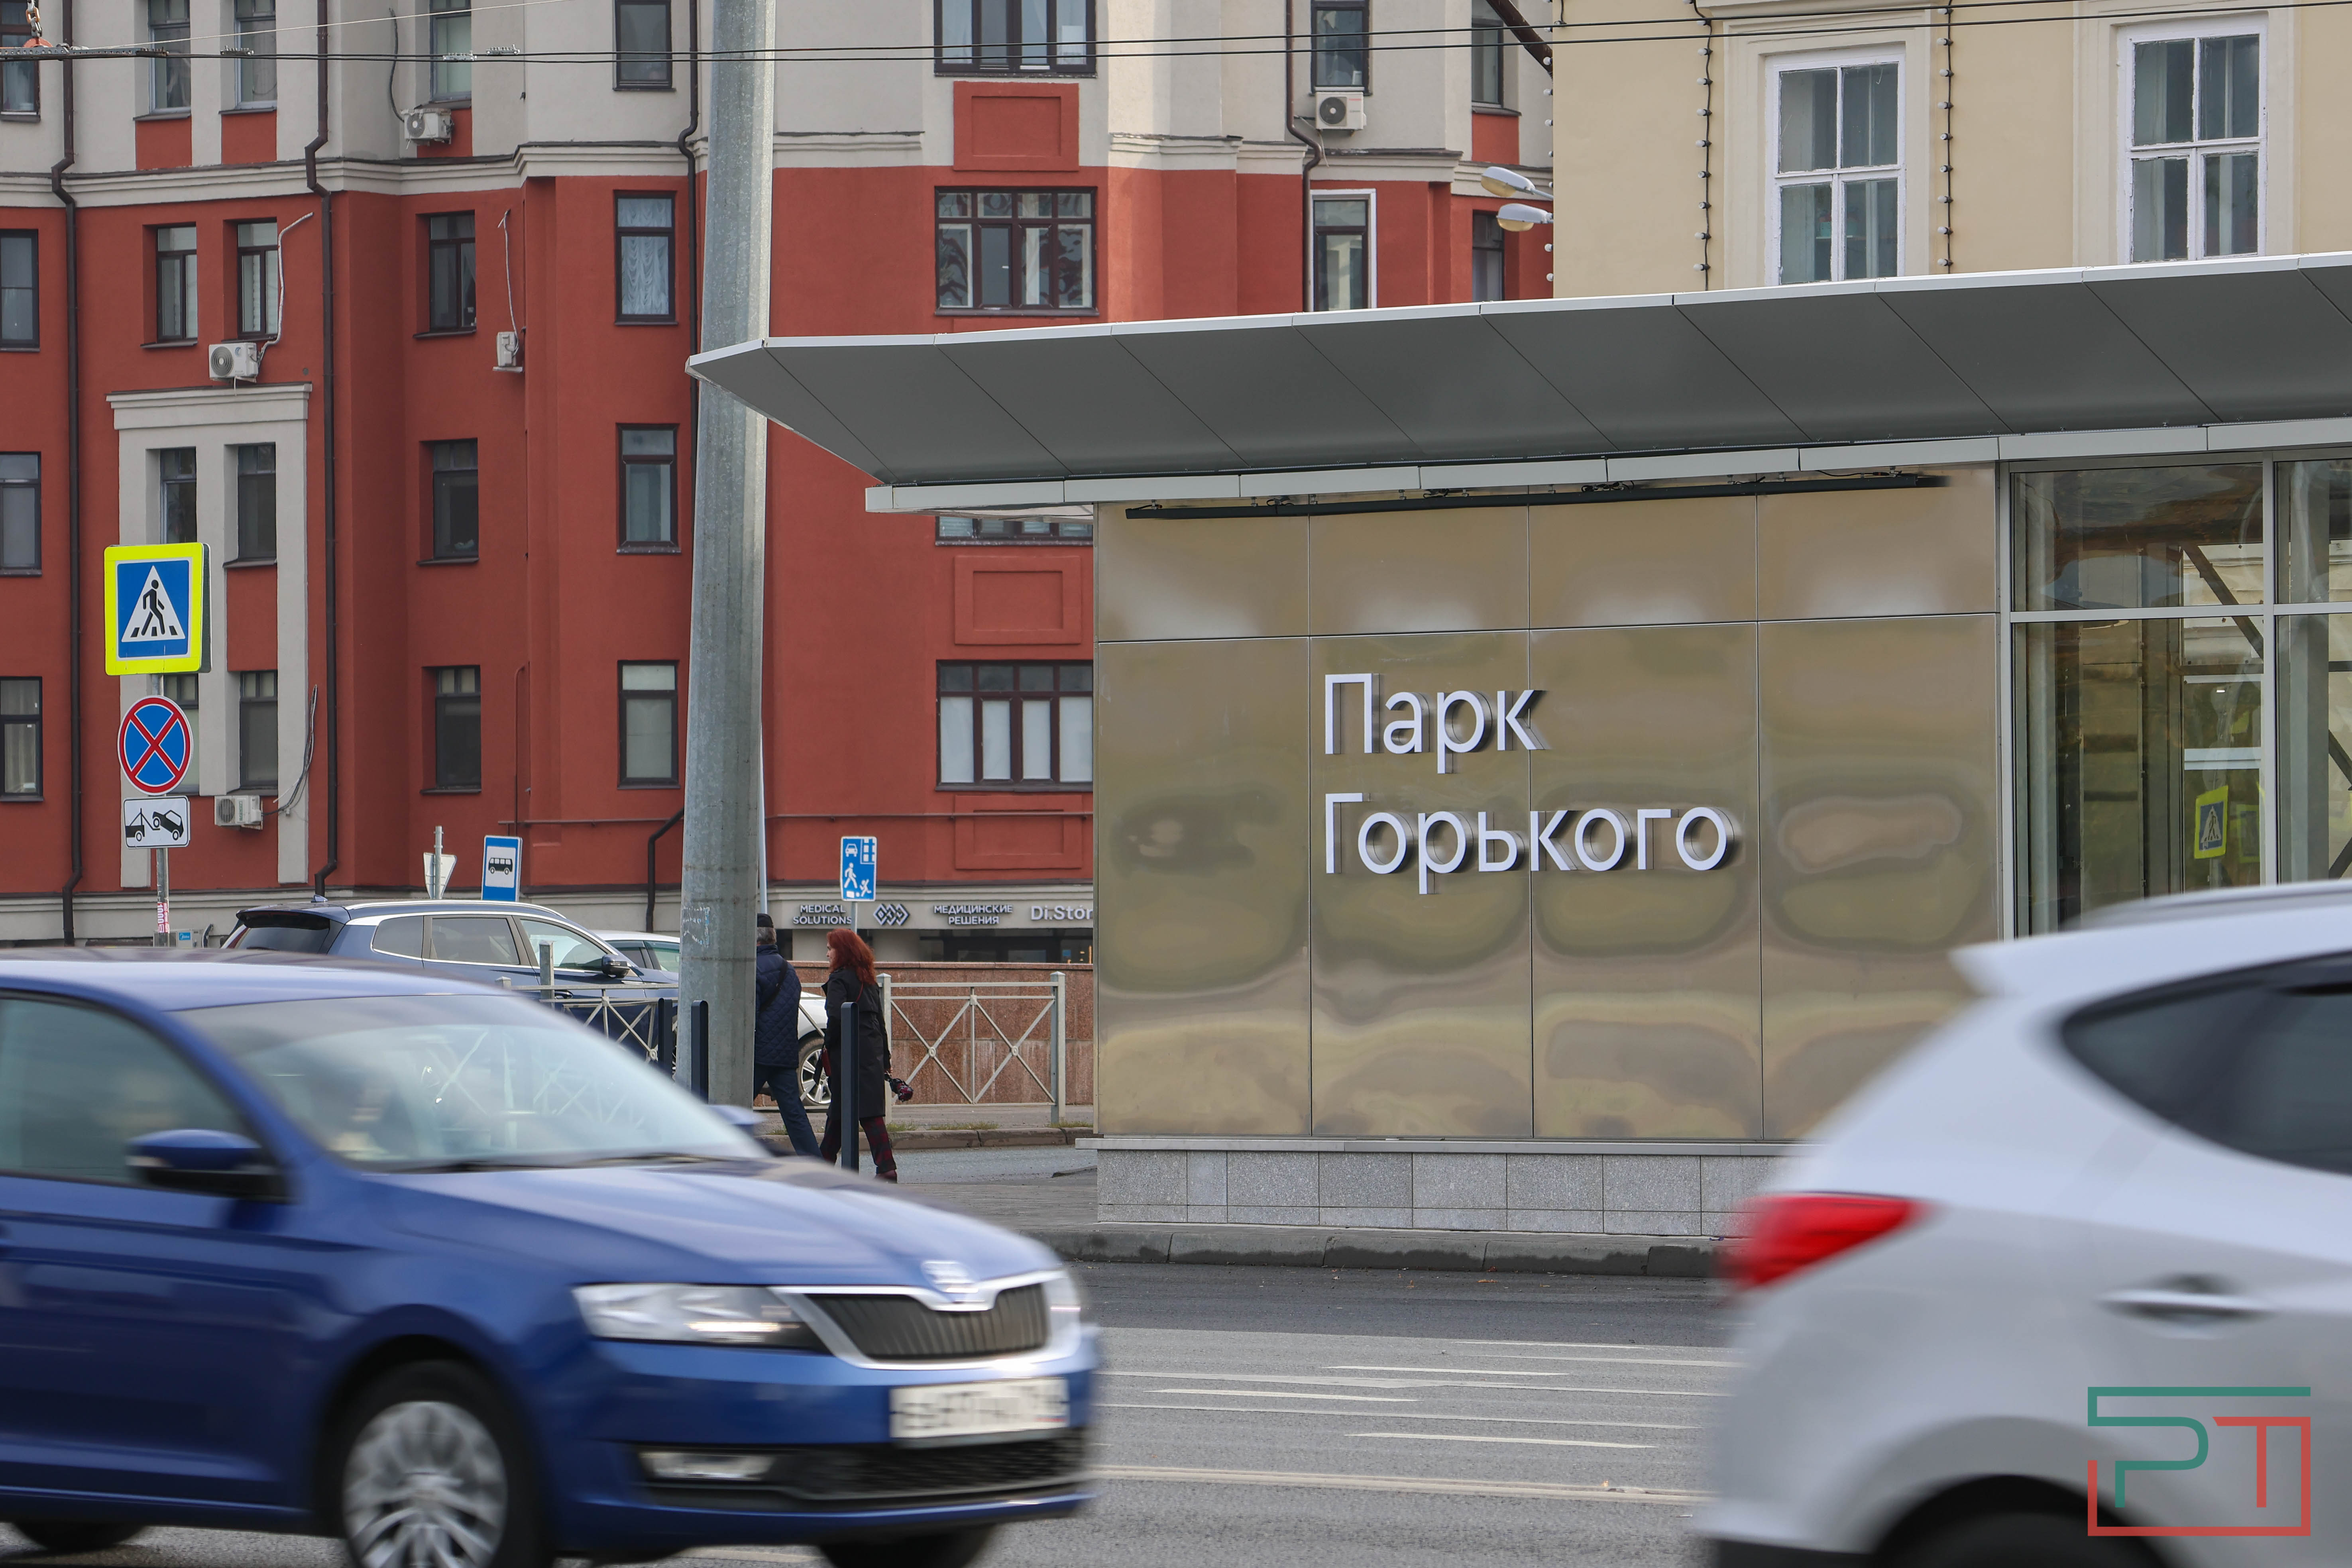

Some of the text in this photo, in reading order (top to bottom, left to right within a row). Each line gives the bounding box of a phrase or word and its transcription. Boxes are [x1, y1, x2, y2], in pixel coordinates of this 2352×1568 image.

[1325, 673, 1545, 774] Парк
[1325, 792, 1731, 894] Горького
[800, 905, 846, 913] MEDICAL
[933, 905, 1013, 914] МЕДИЦИНСКИЕ
[793, 916, 852, 925] SOLUTIONS
[948, 916, 999, 925] РЕШЕНИЯ
